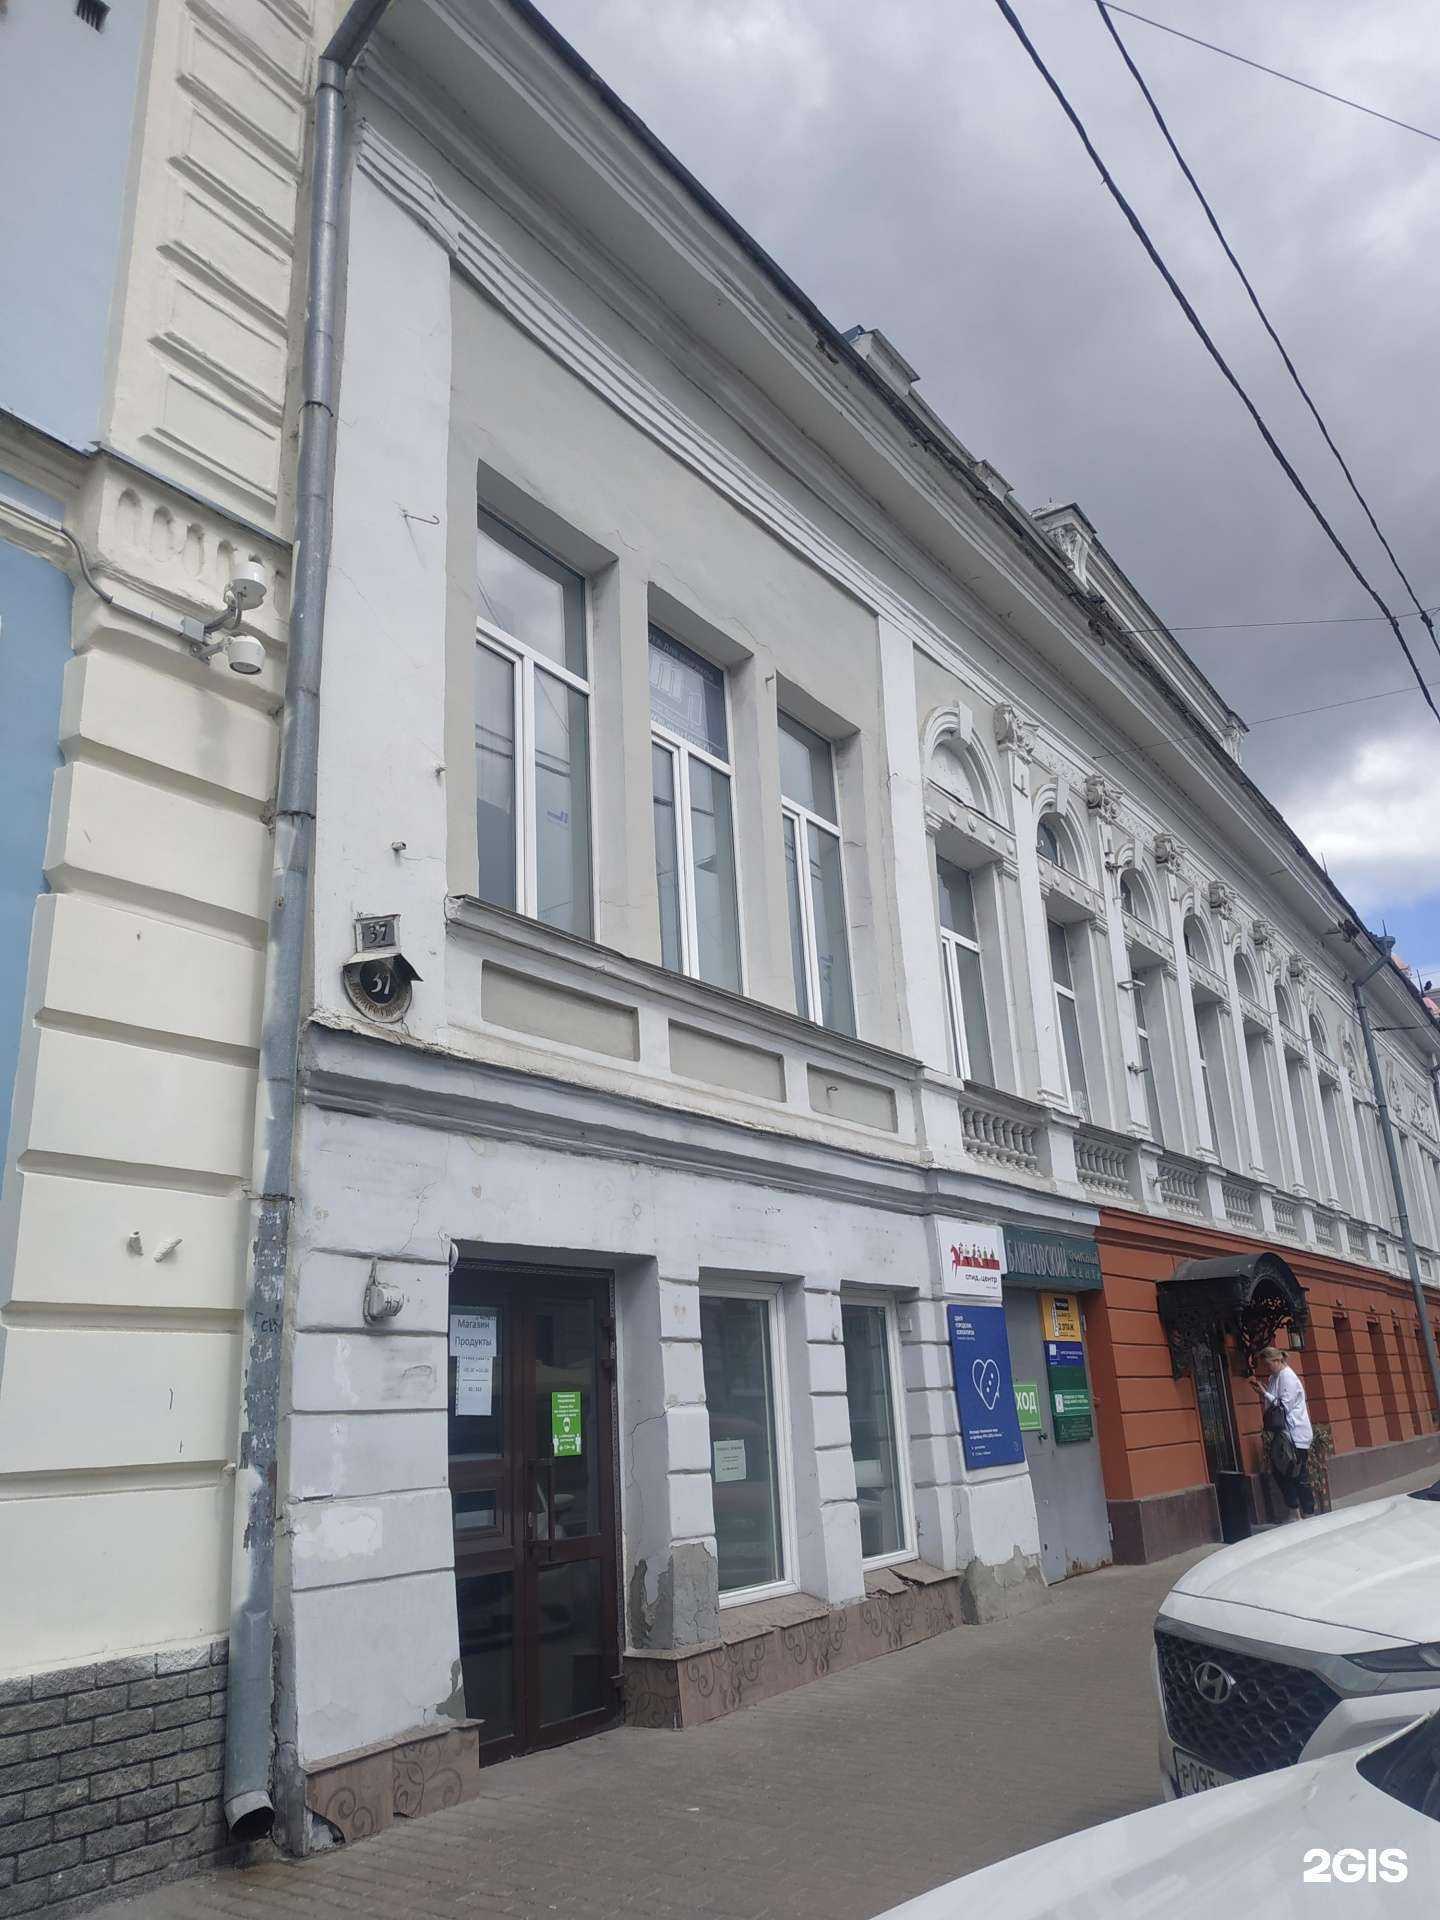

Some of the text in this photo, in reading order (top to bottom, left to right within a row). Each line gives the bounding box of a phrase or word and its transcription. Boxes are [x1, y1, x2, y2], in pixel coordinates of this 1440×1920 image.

[368, 922, 388, 943] 37
[457, 1319, 490, 1328] Магазин
[455, 1336, 492, 1348] Продукты
[1015, 1391, 1038, 1414] ХОД
